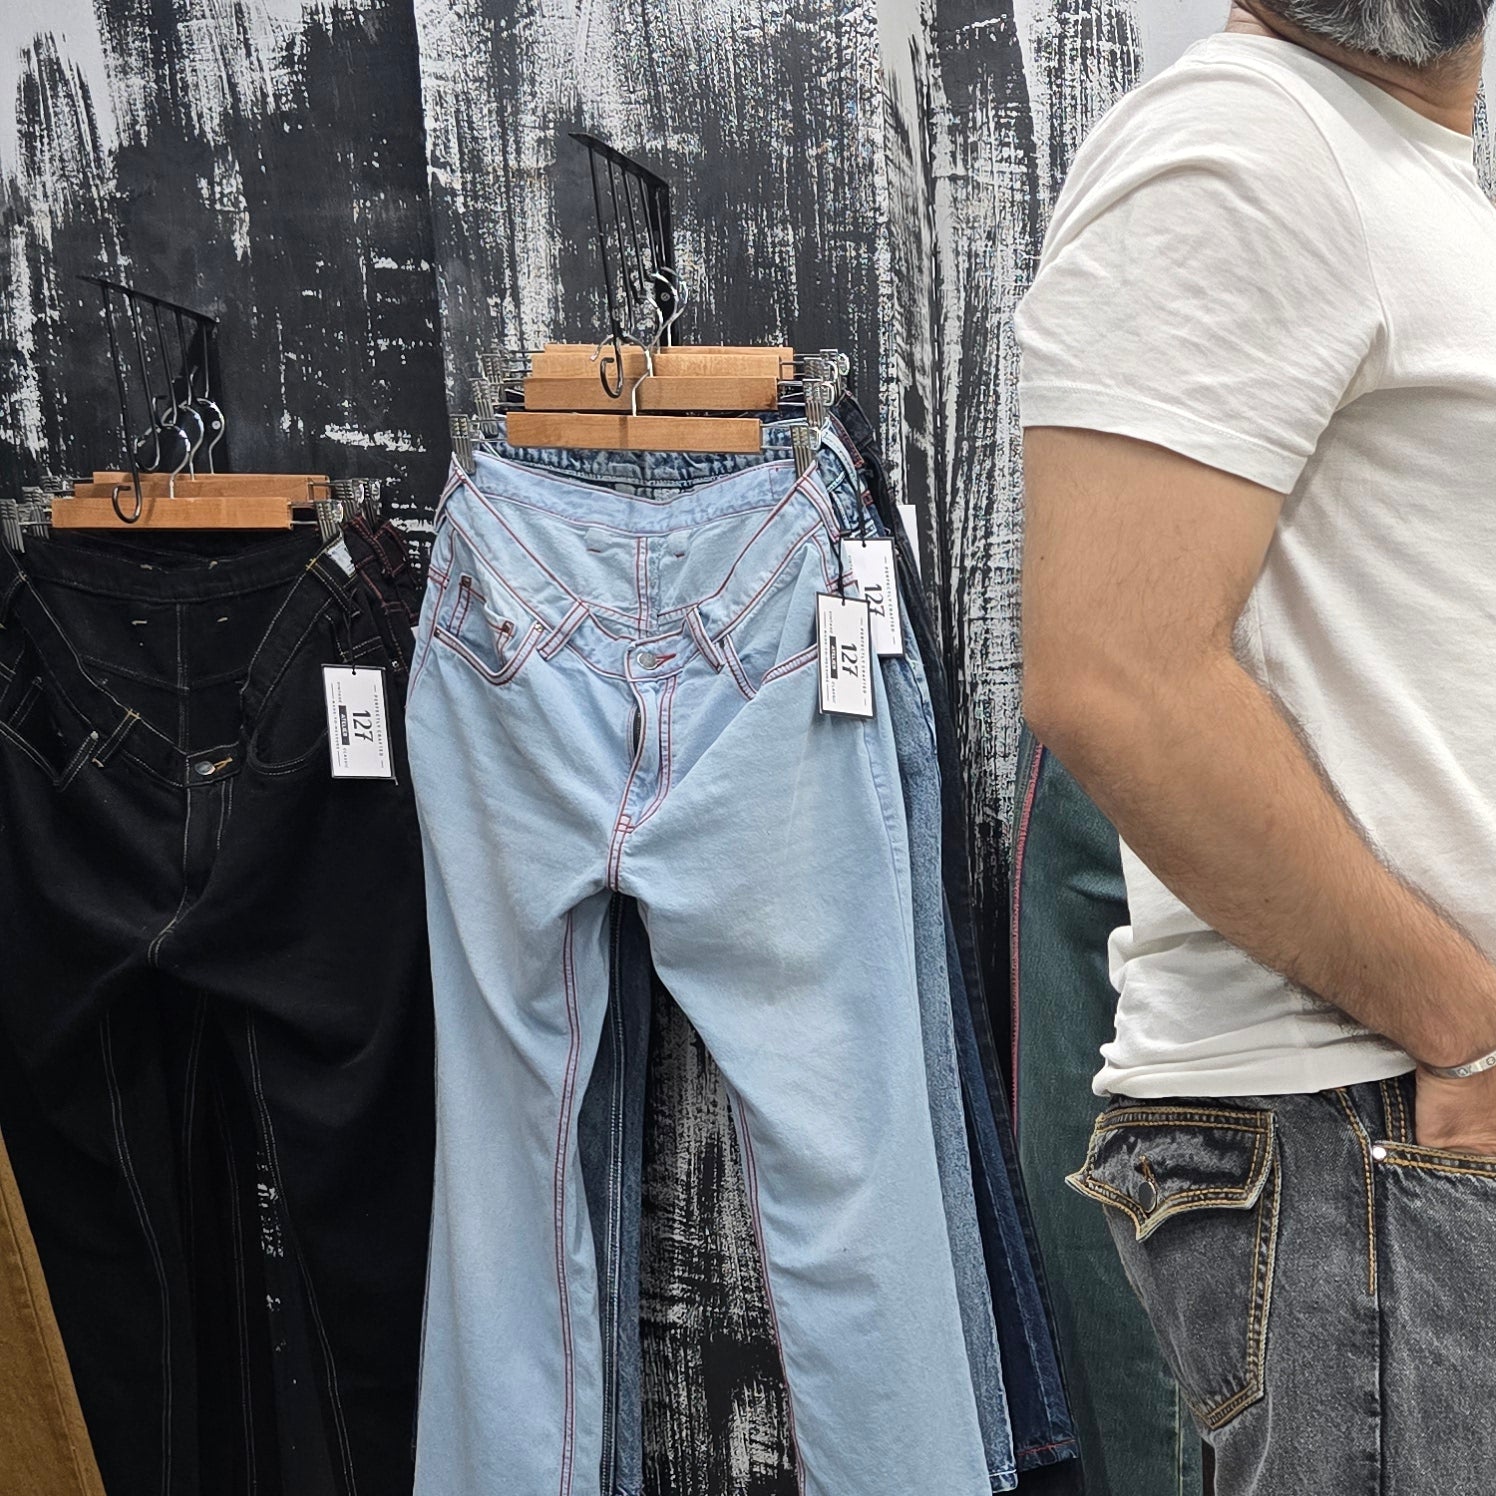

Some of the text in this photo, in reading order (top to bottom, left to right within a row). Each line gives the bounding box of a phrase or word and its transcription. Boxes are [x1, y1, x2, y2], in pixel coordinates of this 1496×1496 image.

[864, 584, 885, 617] 127
[841, 643, 859, 678] 127
[352, 710, 373, 742] 127
[373, 695, 384, 756] PERFECTLY CRAFTED
